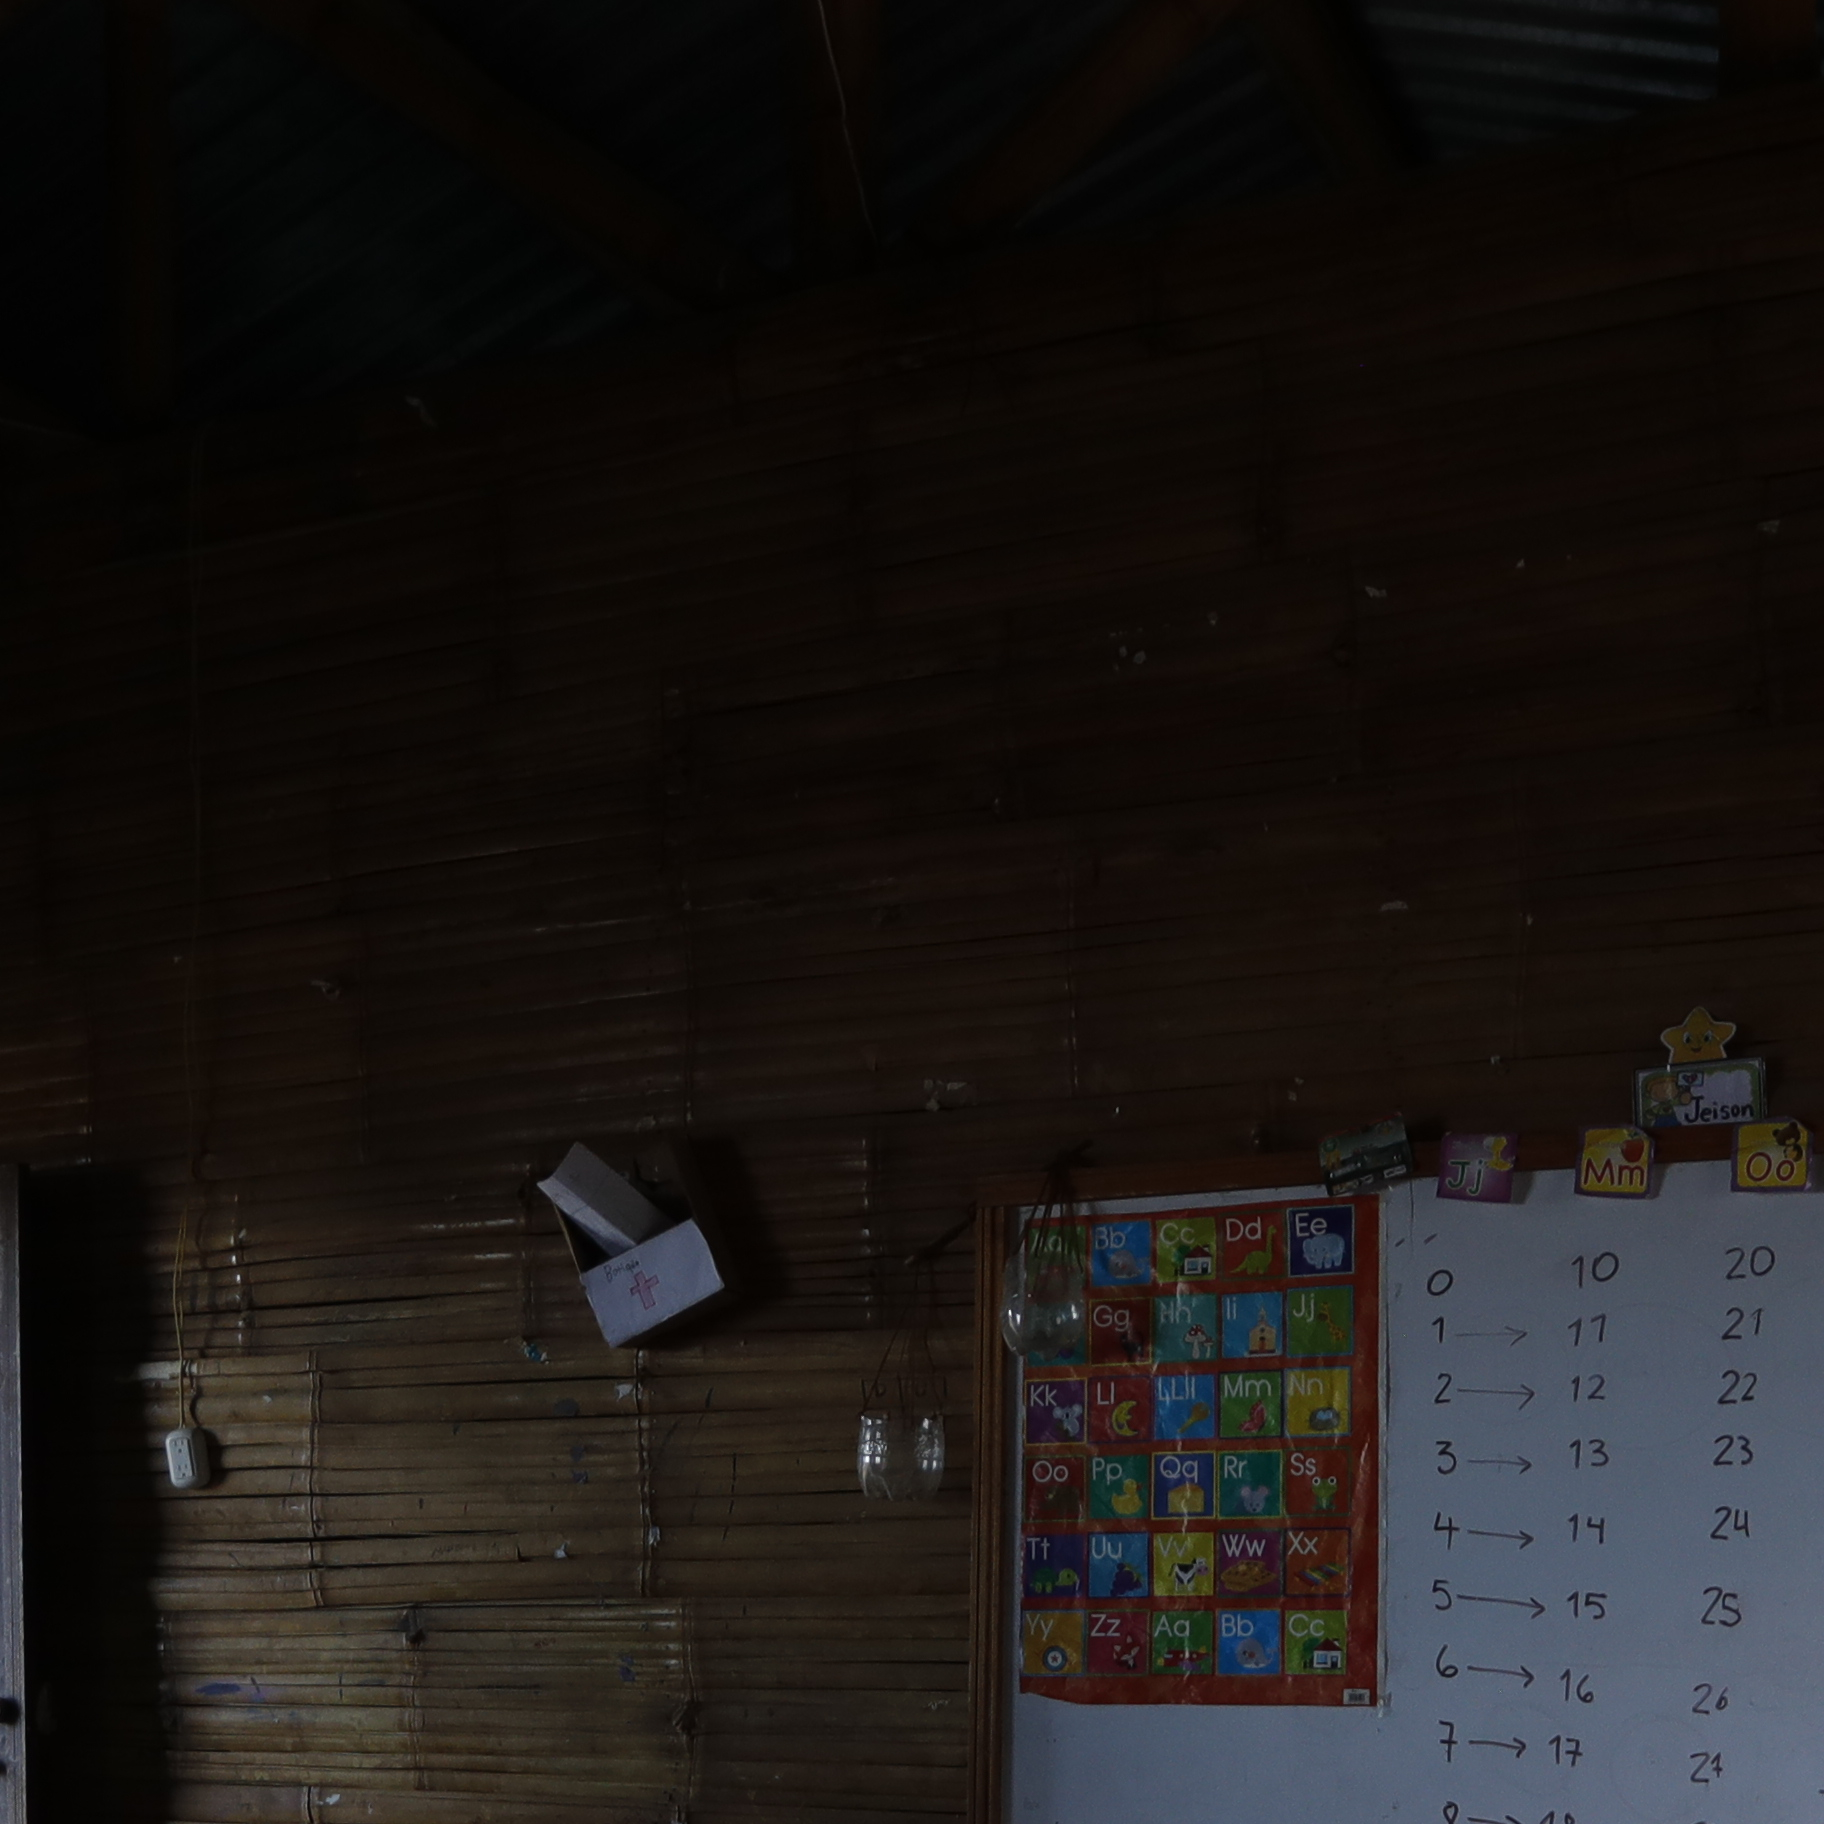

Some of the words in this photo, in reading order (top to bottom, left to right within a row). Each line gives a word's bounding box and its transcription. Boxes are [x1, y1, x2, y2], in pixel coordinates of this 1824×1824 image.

[1683, 1099, 1755, 1125] Jeison
[1447, 1159, 1482, 1194] Jj
[1582, 1156, 1645, 1187] Mm
[1746, 1151, 1796, 1185] Oo
[1094, 1227, 1125, 1250] Bb
[1159, 1223, 1195, 1246] Cc
[1226, 1216, 1262, 1242] Dd
[1295, 1212, 1327, 1238] Ee
[1427, 1269, 1453, 1296] 0
[1570, 1252, 1619, 1288] 10
[1725, 1246, 1775, 1279] 20
[1093, 1304, 1131, 1335] Gg
[1292, 1294, 1316, 1321] Jj
[1432, 1316, 1445, 1343] 1
[1568, 1314, 1607, 1345] 11
[1721, 1307, 1765, 1340] 21
[1029, 1384, 1057, 1407] Kk
[1224, 1374, 1272, 1398] Mm
[1290, 1372, 1324, 1396] Nn
[1433, 1373, 1452, 1404] 2
[1569, 1375, 1606, 1403] 12
[1717, 1370, 1758, 1405] 22
[1032, 1460, 1069, 1483] Oo
[1092, 1457, 1122, 1485] Pp
[1160, 1456, 1199, 1486] Qq
[1224, 1455, 1248, 1479] Rr
[1290, 1453, 1316, 1476] Ss
[1435, 1440, 1457, 1474] 3
[1569, 1439, 1609, 1469] 13
[1713, 1435, 1753, 1466] 23
[1026, 1537, 1050, 1560] Tt
[1091, 1536, 1123, 1559] Uu
[1159, 1535, 1194, 1558] Vv
[1222, 1534, 1266, 1558] Ww
[1288, 1531, 1319, 1555] Xx
[1434, 1512, 1460, 1550] 4
[1569, 1513, 1605, 1544] 14
[1710, 1506, 1750, 1540] 24
[1432, 1580, 1452, 1611] 5
[1566, 1590, 1607, 1620] 15
[1701, 1587, 1742, 1628] 25
[1026, 1615, 1055, 1641] Yy
[1090, 1615, 1121, 1637] Zz
[1154, 1615, 1191, 1638] Aa
[1221, 1614, 1254, 1637] Bb
[1289, 1614, 1324, 1637] Cc
[1436, 1645, 1458, 1678] 6
[1559, 1669, 1594, 1703] 16
[1693, 1684, 1728, 1714] 26
[1439, 1721, 1457, 1763] 7
[1549, 1735, 1583, 1766] 17
[1690, 1752, 1723, 1783] 27
